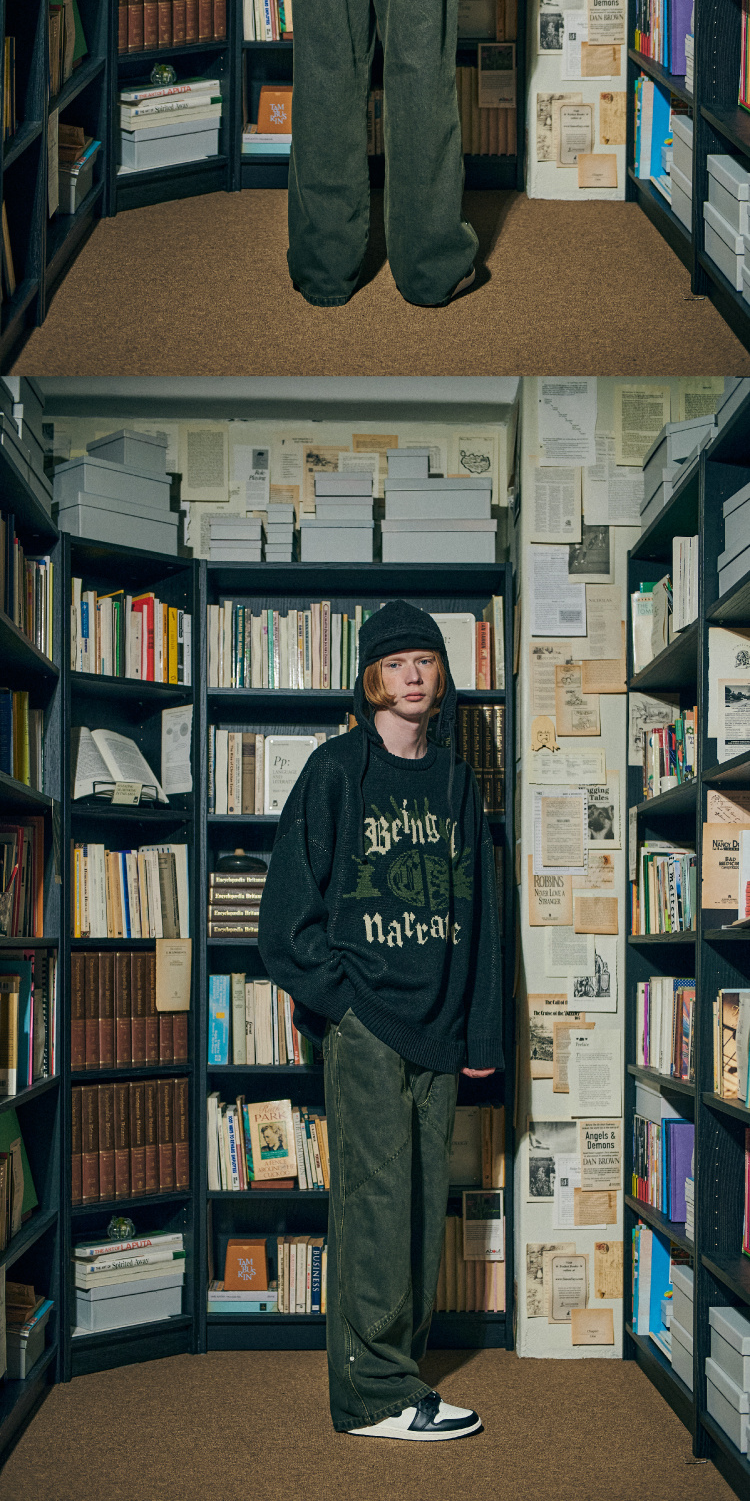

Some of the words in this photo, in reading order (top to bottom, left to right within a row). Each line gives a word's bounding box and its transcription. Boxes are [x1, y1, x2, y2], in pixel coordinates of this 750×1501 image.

[162, 85, 192, 96] LAPUTA
[273, 755, 290, 768] Pp:
[364, 799, 440, 856] Being
[254, 1112, 287, 1122] PARK
[585, 1131, 608, 1142] Angels
[610, 1131, 616, 1140] &
[587, 1140, 615, 1149] Demons
[598, 1157, 620, 1165] BROWN
[121, 1240, 152, 1251] LAPUTA
[112, 1259, 133, 1269] Spirited
